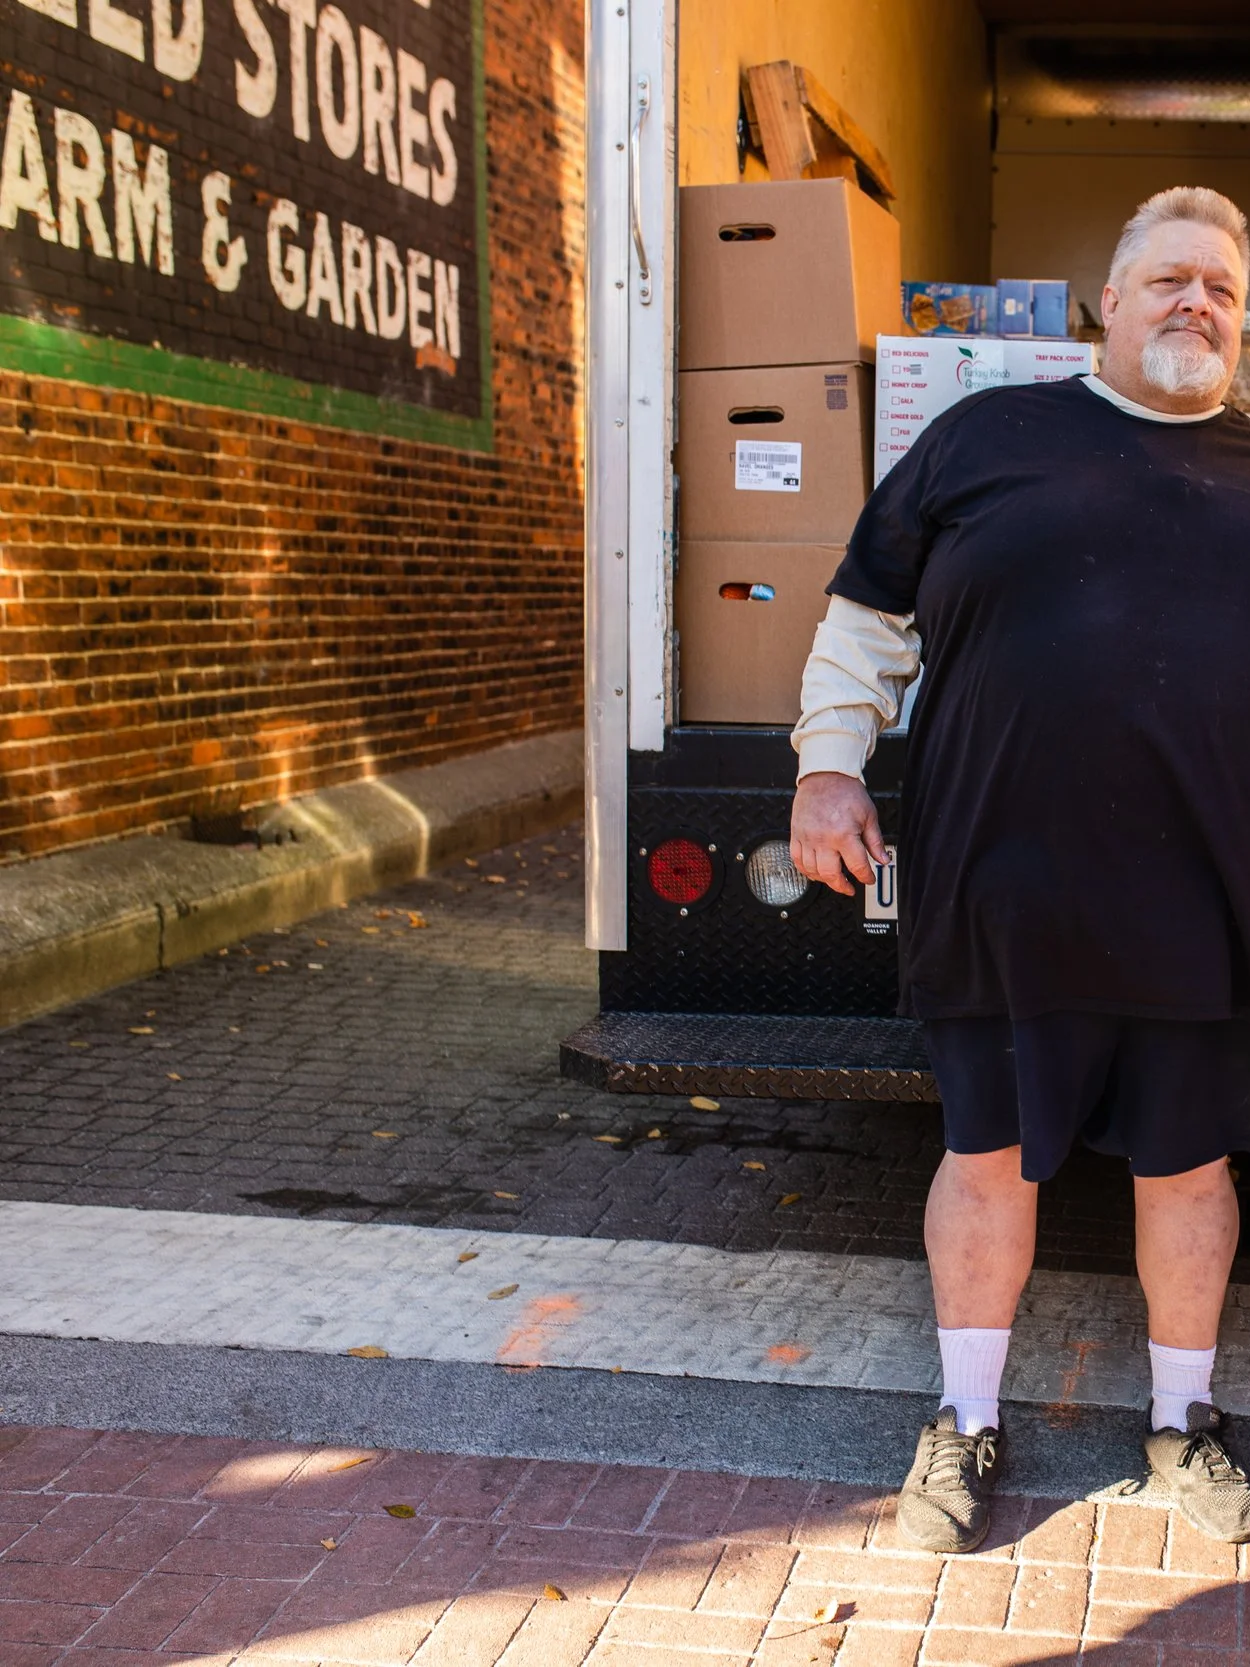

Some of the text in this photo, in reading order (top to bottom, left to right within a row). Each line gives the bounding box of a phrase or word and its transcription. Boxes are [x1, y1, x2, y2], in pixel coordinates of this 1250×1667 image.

[234, 0, 457, 206] STORES
[201, 171, 247, 292] &
[267, 198, 461, 359] GARDEN
[990, 368, 1010, 379] Knob
[876, 865, 895, 907] U
